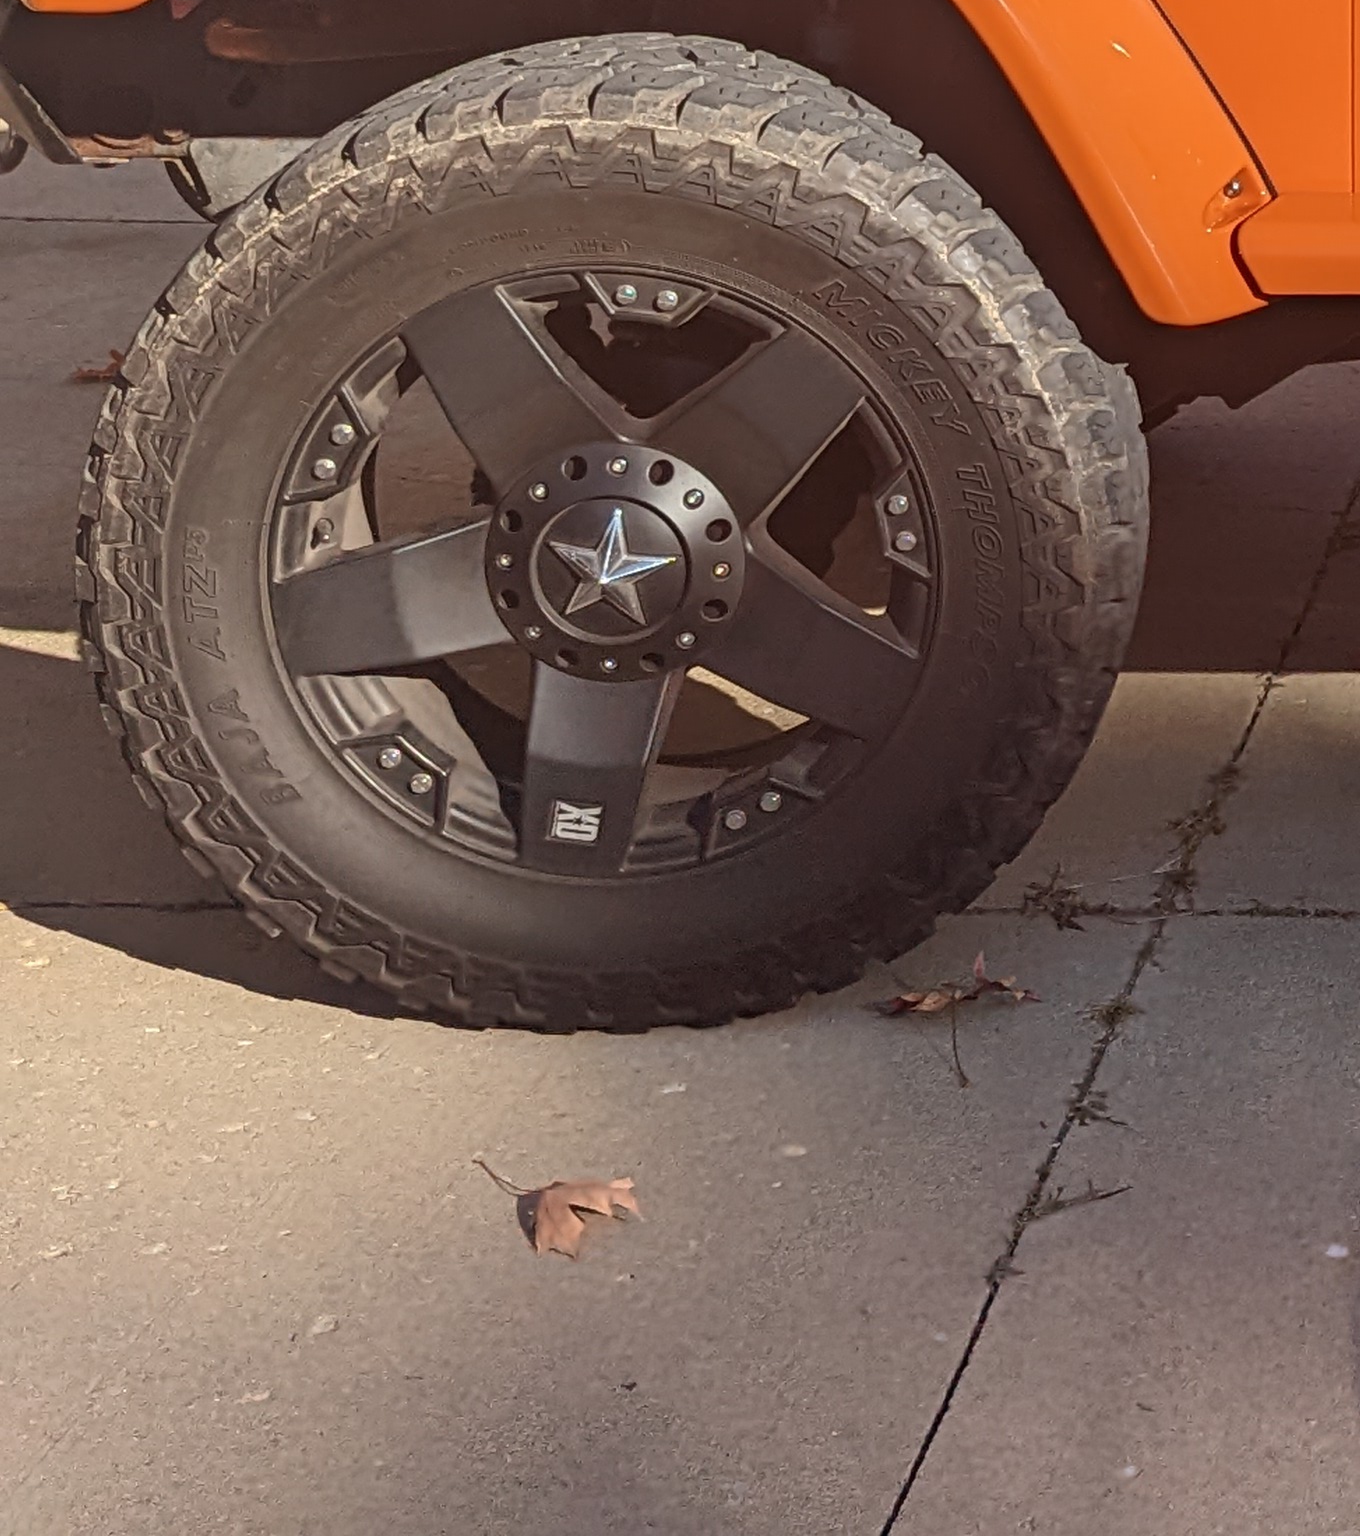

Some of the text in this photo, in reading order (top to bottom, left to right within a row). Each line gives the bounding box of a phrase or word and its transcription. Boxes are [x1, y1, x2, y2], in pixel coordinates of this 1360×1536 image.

[813, 279, 1004, 693] MICKEY THOMPSO
[207, 687, 303, 806] BAJA
